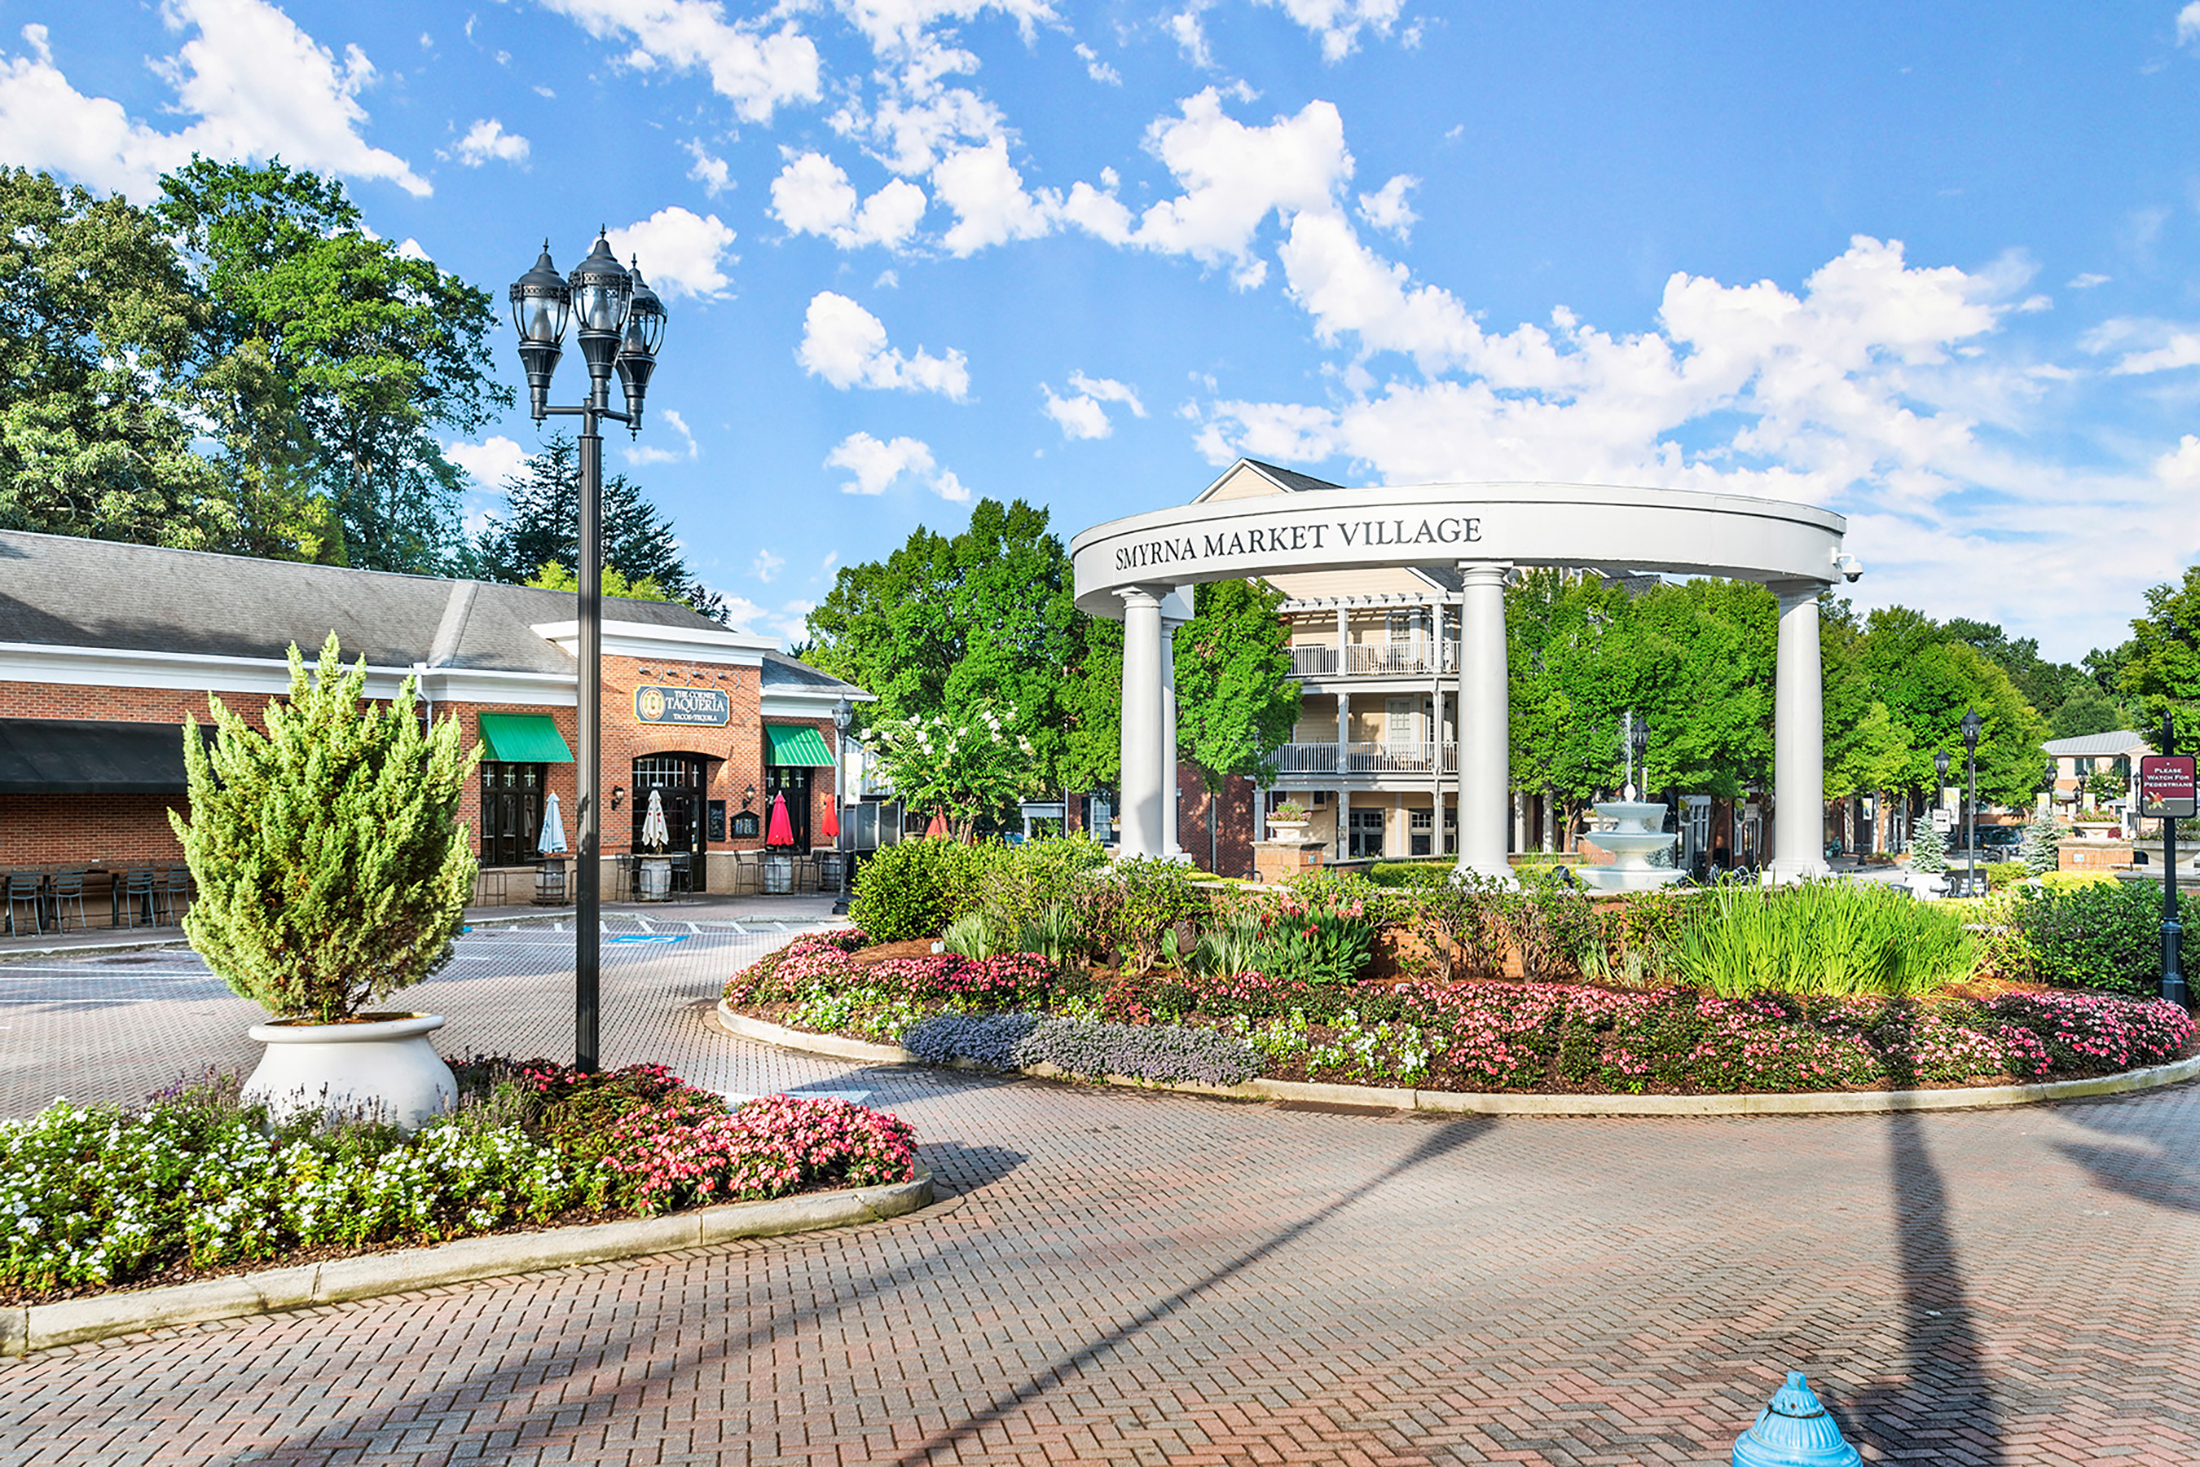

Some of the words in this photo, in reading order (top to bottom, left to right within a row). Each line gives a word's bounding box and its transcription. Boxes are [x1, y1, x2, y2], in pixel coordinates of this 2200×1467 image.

[1115, 537, 1197, 571] SMYRNA
[1203, 525, 1329, 558] MARKET
[1337, 517, 1482, 546] VILLAGE
[666, 697, 725, 713] TAQUERIA
